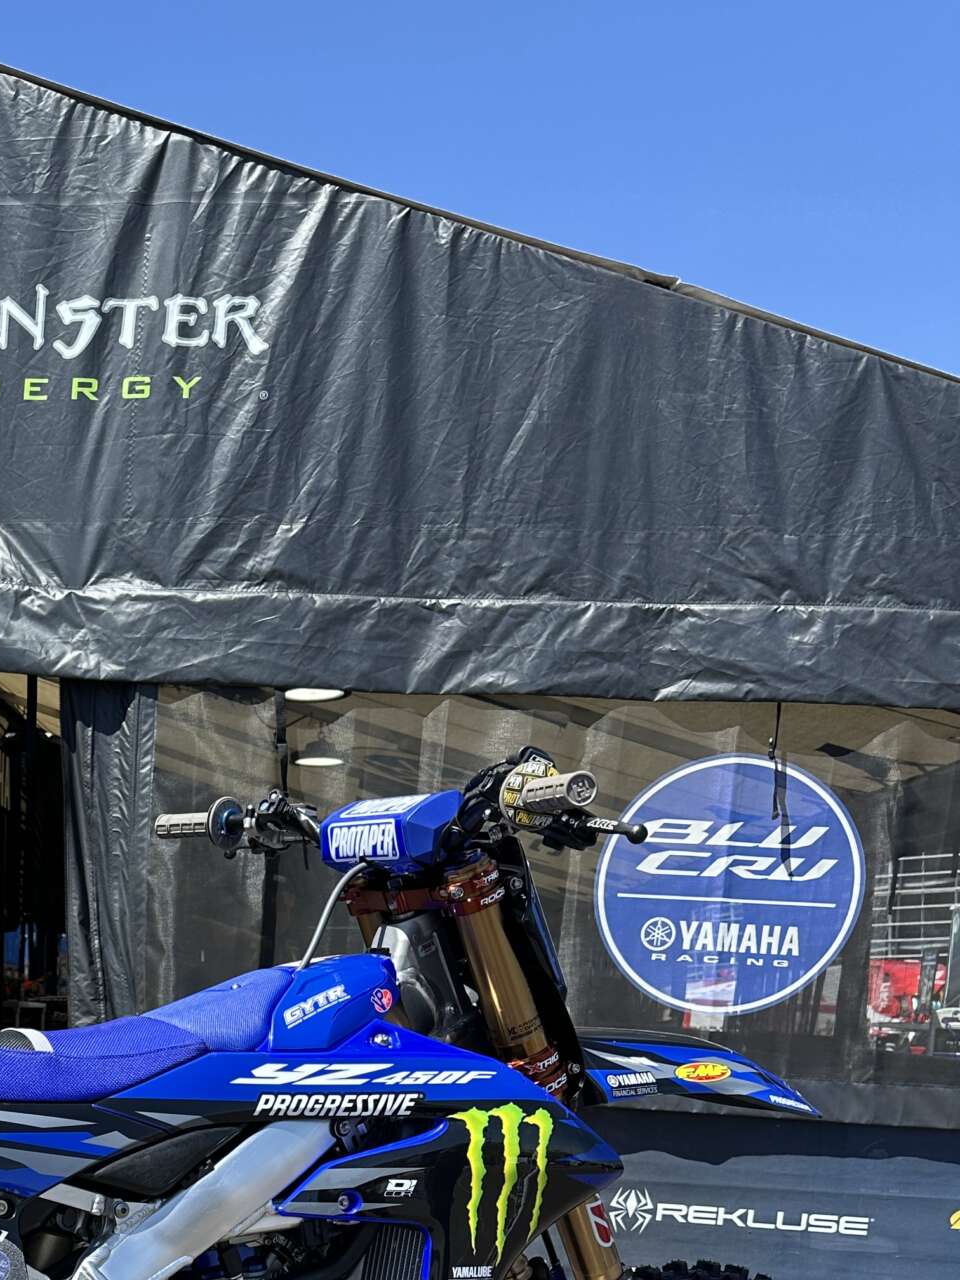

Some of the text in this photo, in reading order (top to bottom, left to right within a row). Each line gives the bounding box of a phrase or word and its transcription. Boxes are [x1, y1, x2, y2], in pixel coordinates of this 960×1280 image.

[331, 823, 394, 859] PROTAPER
[635, 850, 840, 882] CRU
[679, 920, 801, 957] YAMAHA
[651, 953, 790, 968] RACING
[284, 984, 348, 1025] GYTR
[617, 1071, 657, 1087] YAMAHA
[253, 1093, 419, 1117] PROGRESSIVE
[655, 1203, 870, 1236] REKLUSE
[452, 1265, 493, 1279] YAMALUBE
